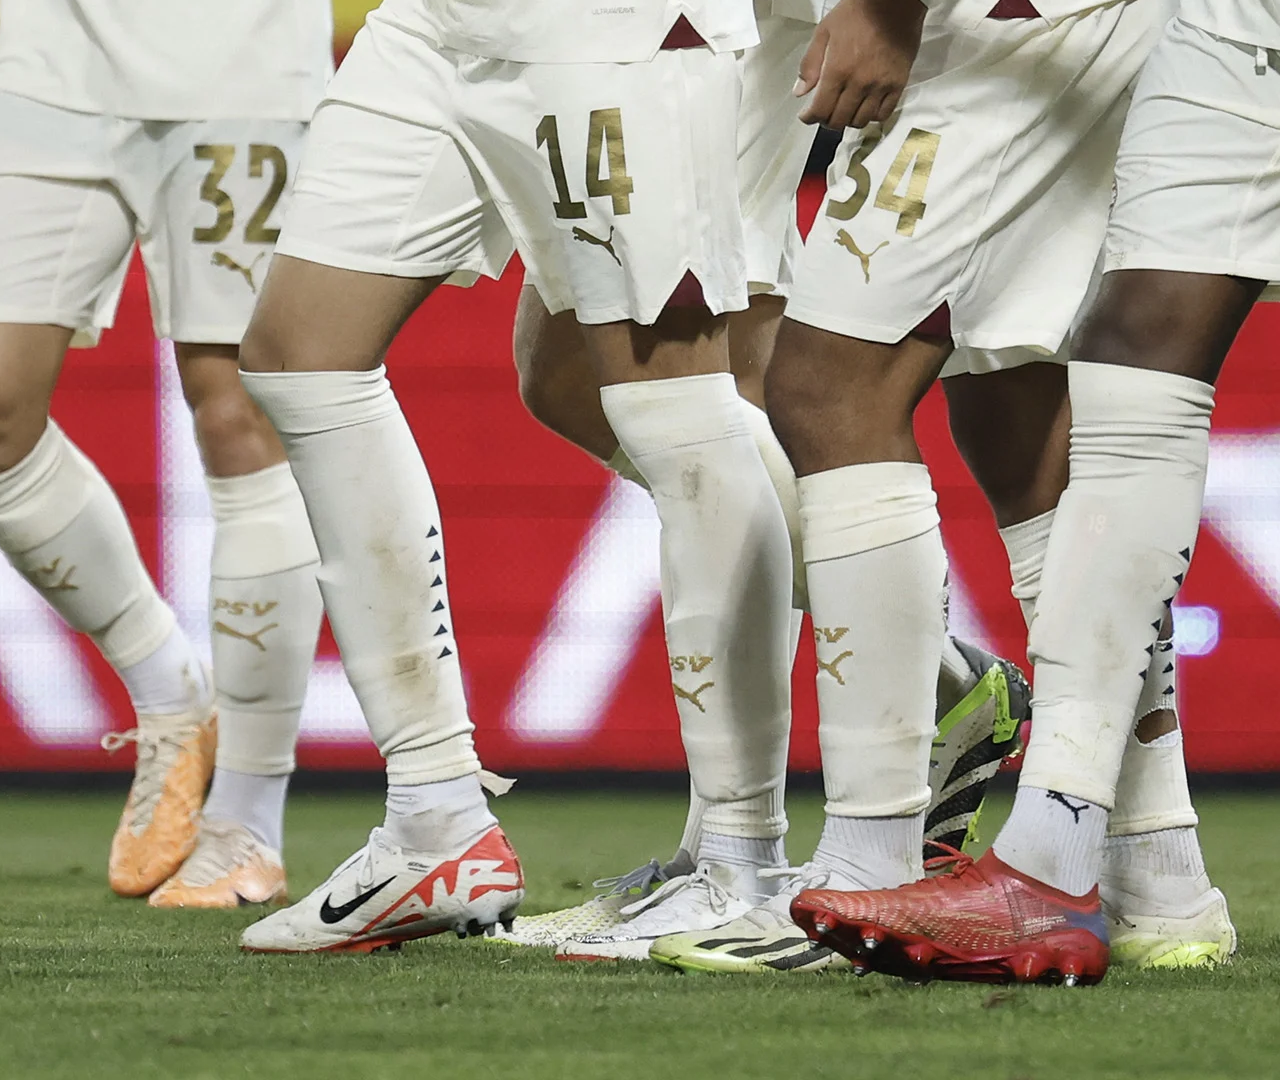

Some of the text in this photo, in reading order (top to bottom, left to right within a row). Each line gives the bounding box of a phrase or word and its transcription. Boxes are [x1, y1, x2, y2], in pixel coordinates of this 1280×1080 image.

[193, 144, 287, 244] 32
[536, 108, 633, 219] 14
[825, 110, 942, 237] 34
[213, 599, 278, 616] PSV
[671, 656, 713, 672] SV
